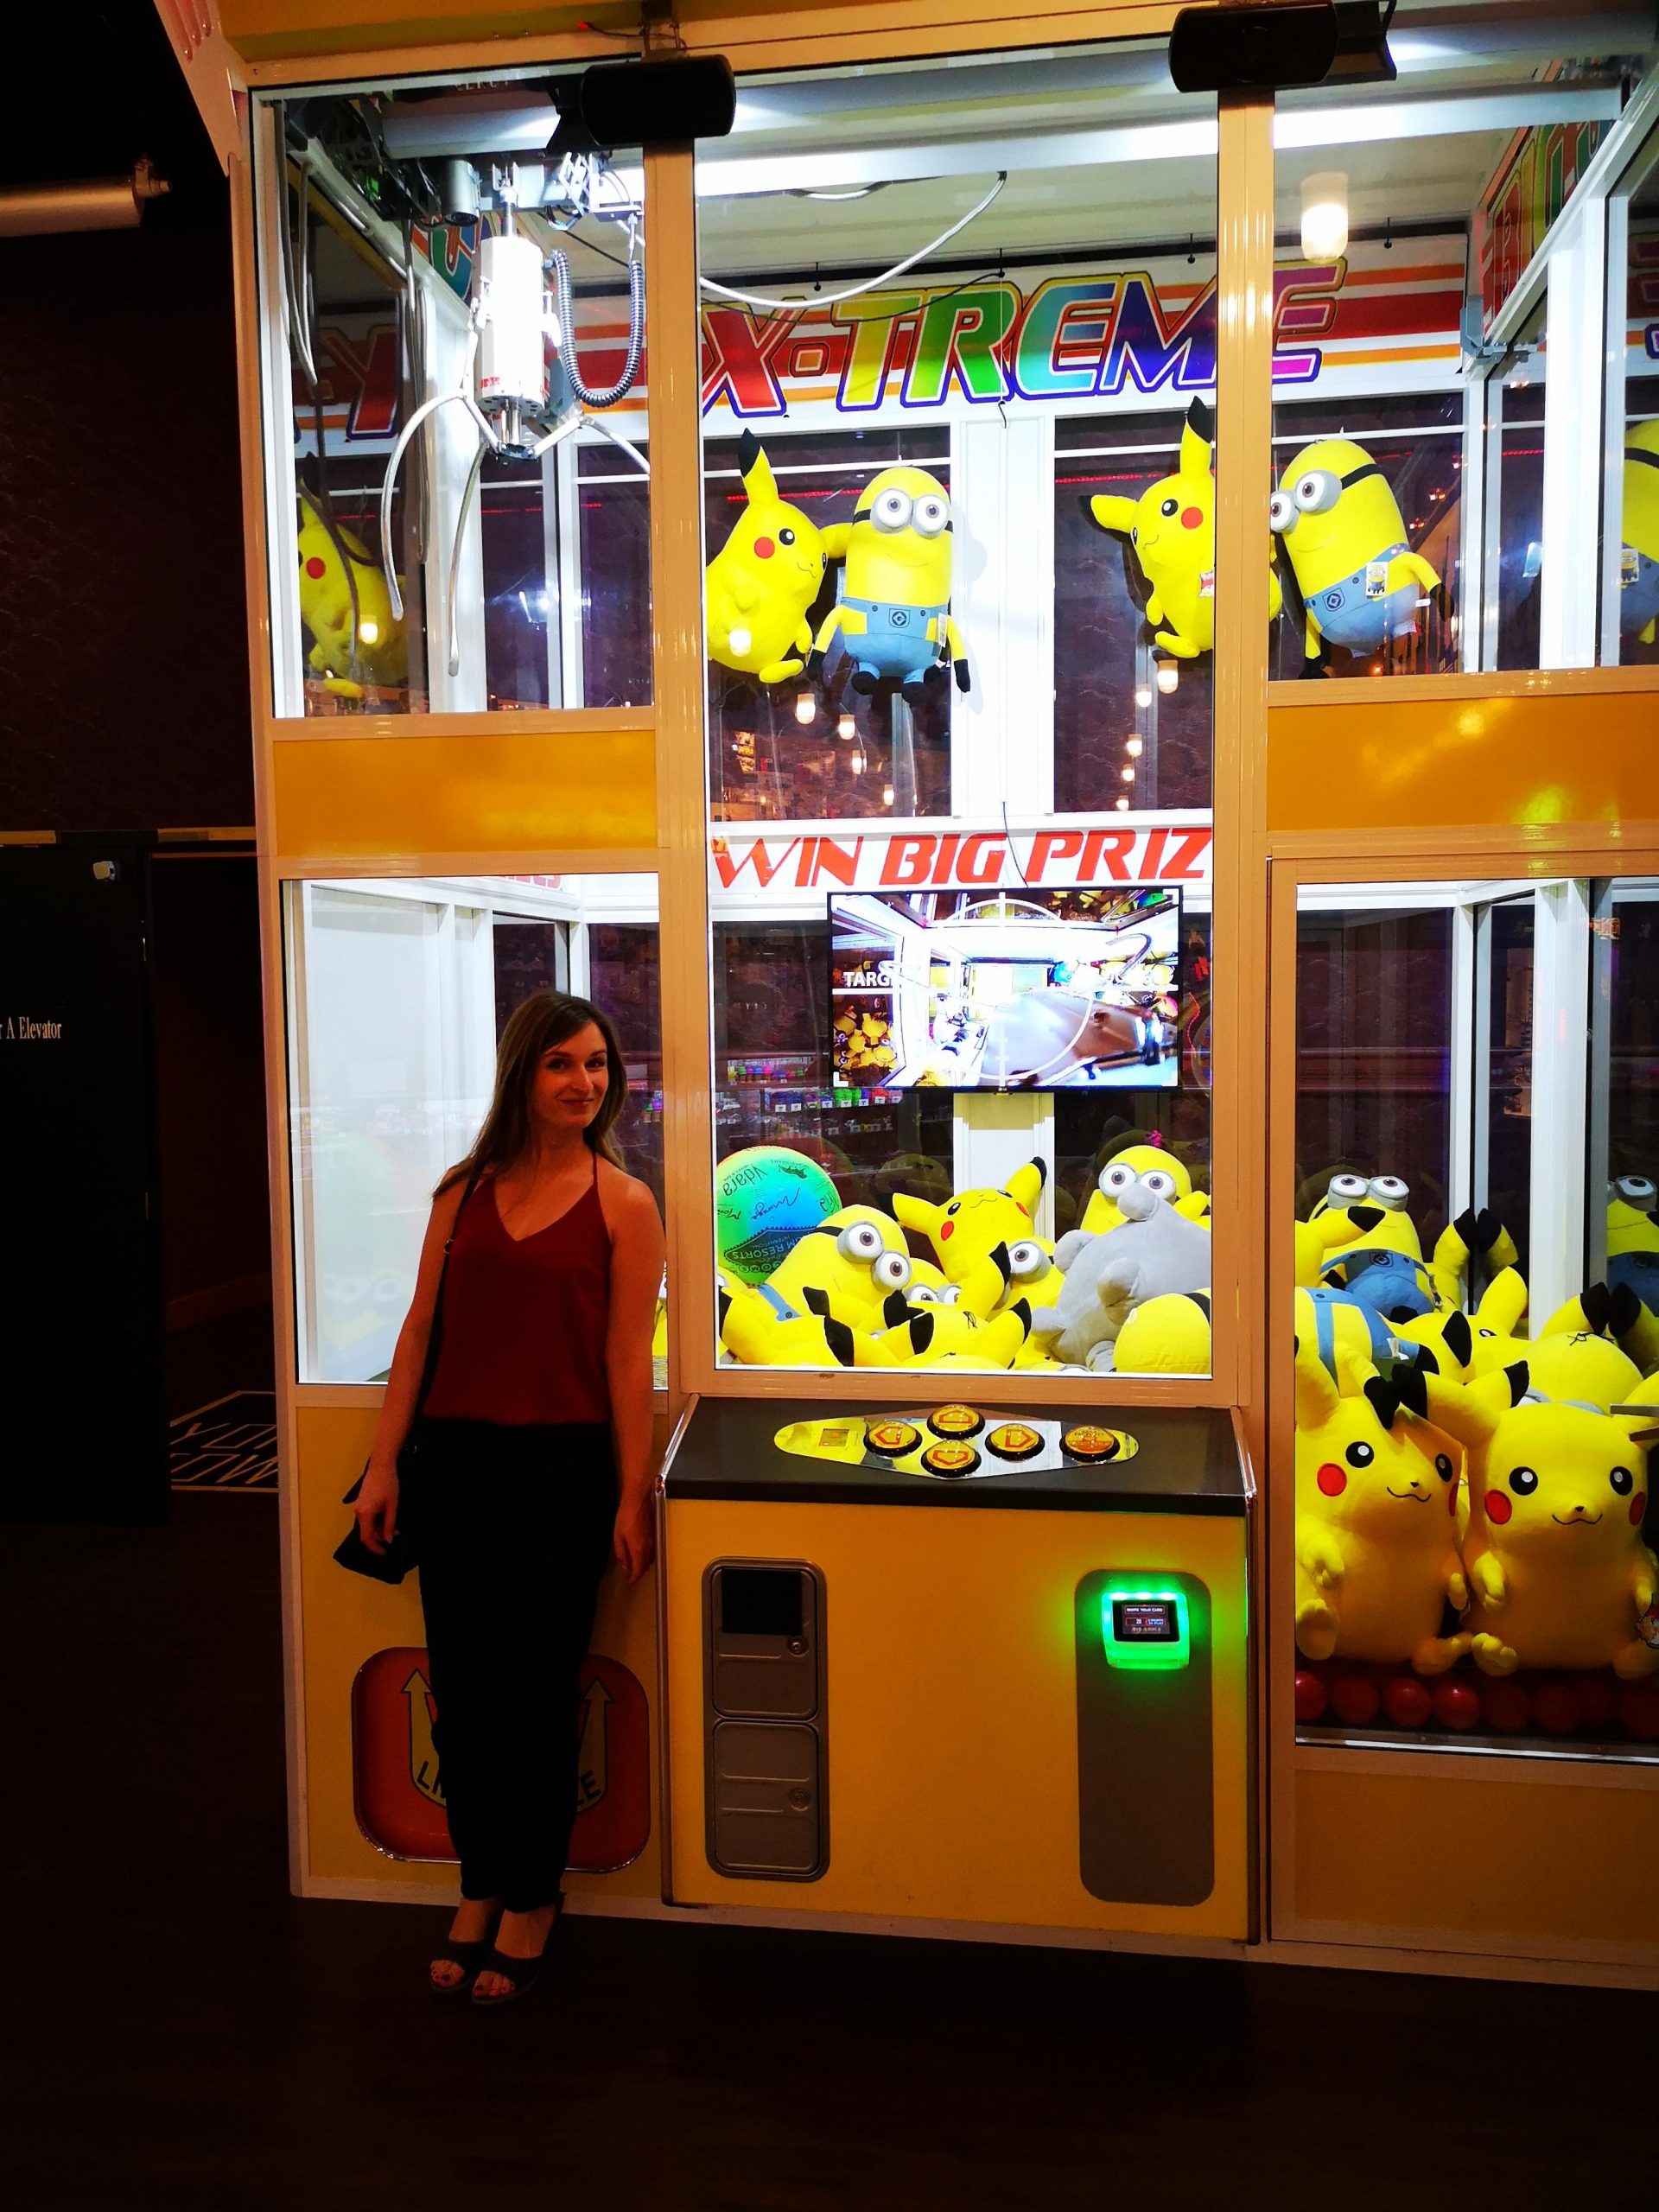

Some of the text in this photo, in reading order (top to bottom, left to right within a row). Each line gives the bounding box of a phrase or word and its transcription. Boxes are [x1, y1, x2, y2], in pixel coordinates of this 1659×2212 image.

[710, 827, 1213, 888] WIN BIG PRIZ
[843, 971, 893, 988] TARG
[6, 1016, 16, 1039] A
[19, 1016, 61, 1039] Elevator
[722, 1166, 769, 1196] Vdara
[733, 1243, 785, 1260] RESORTS
